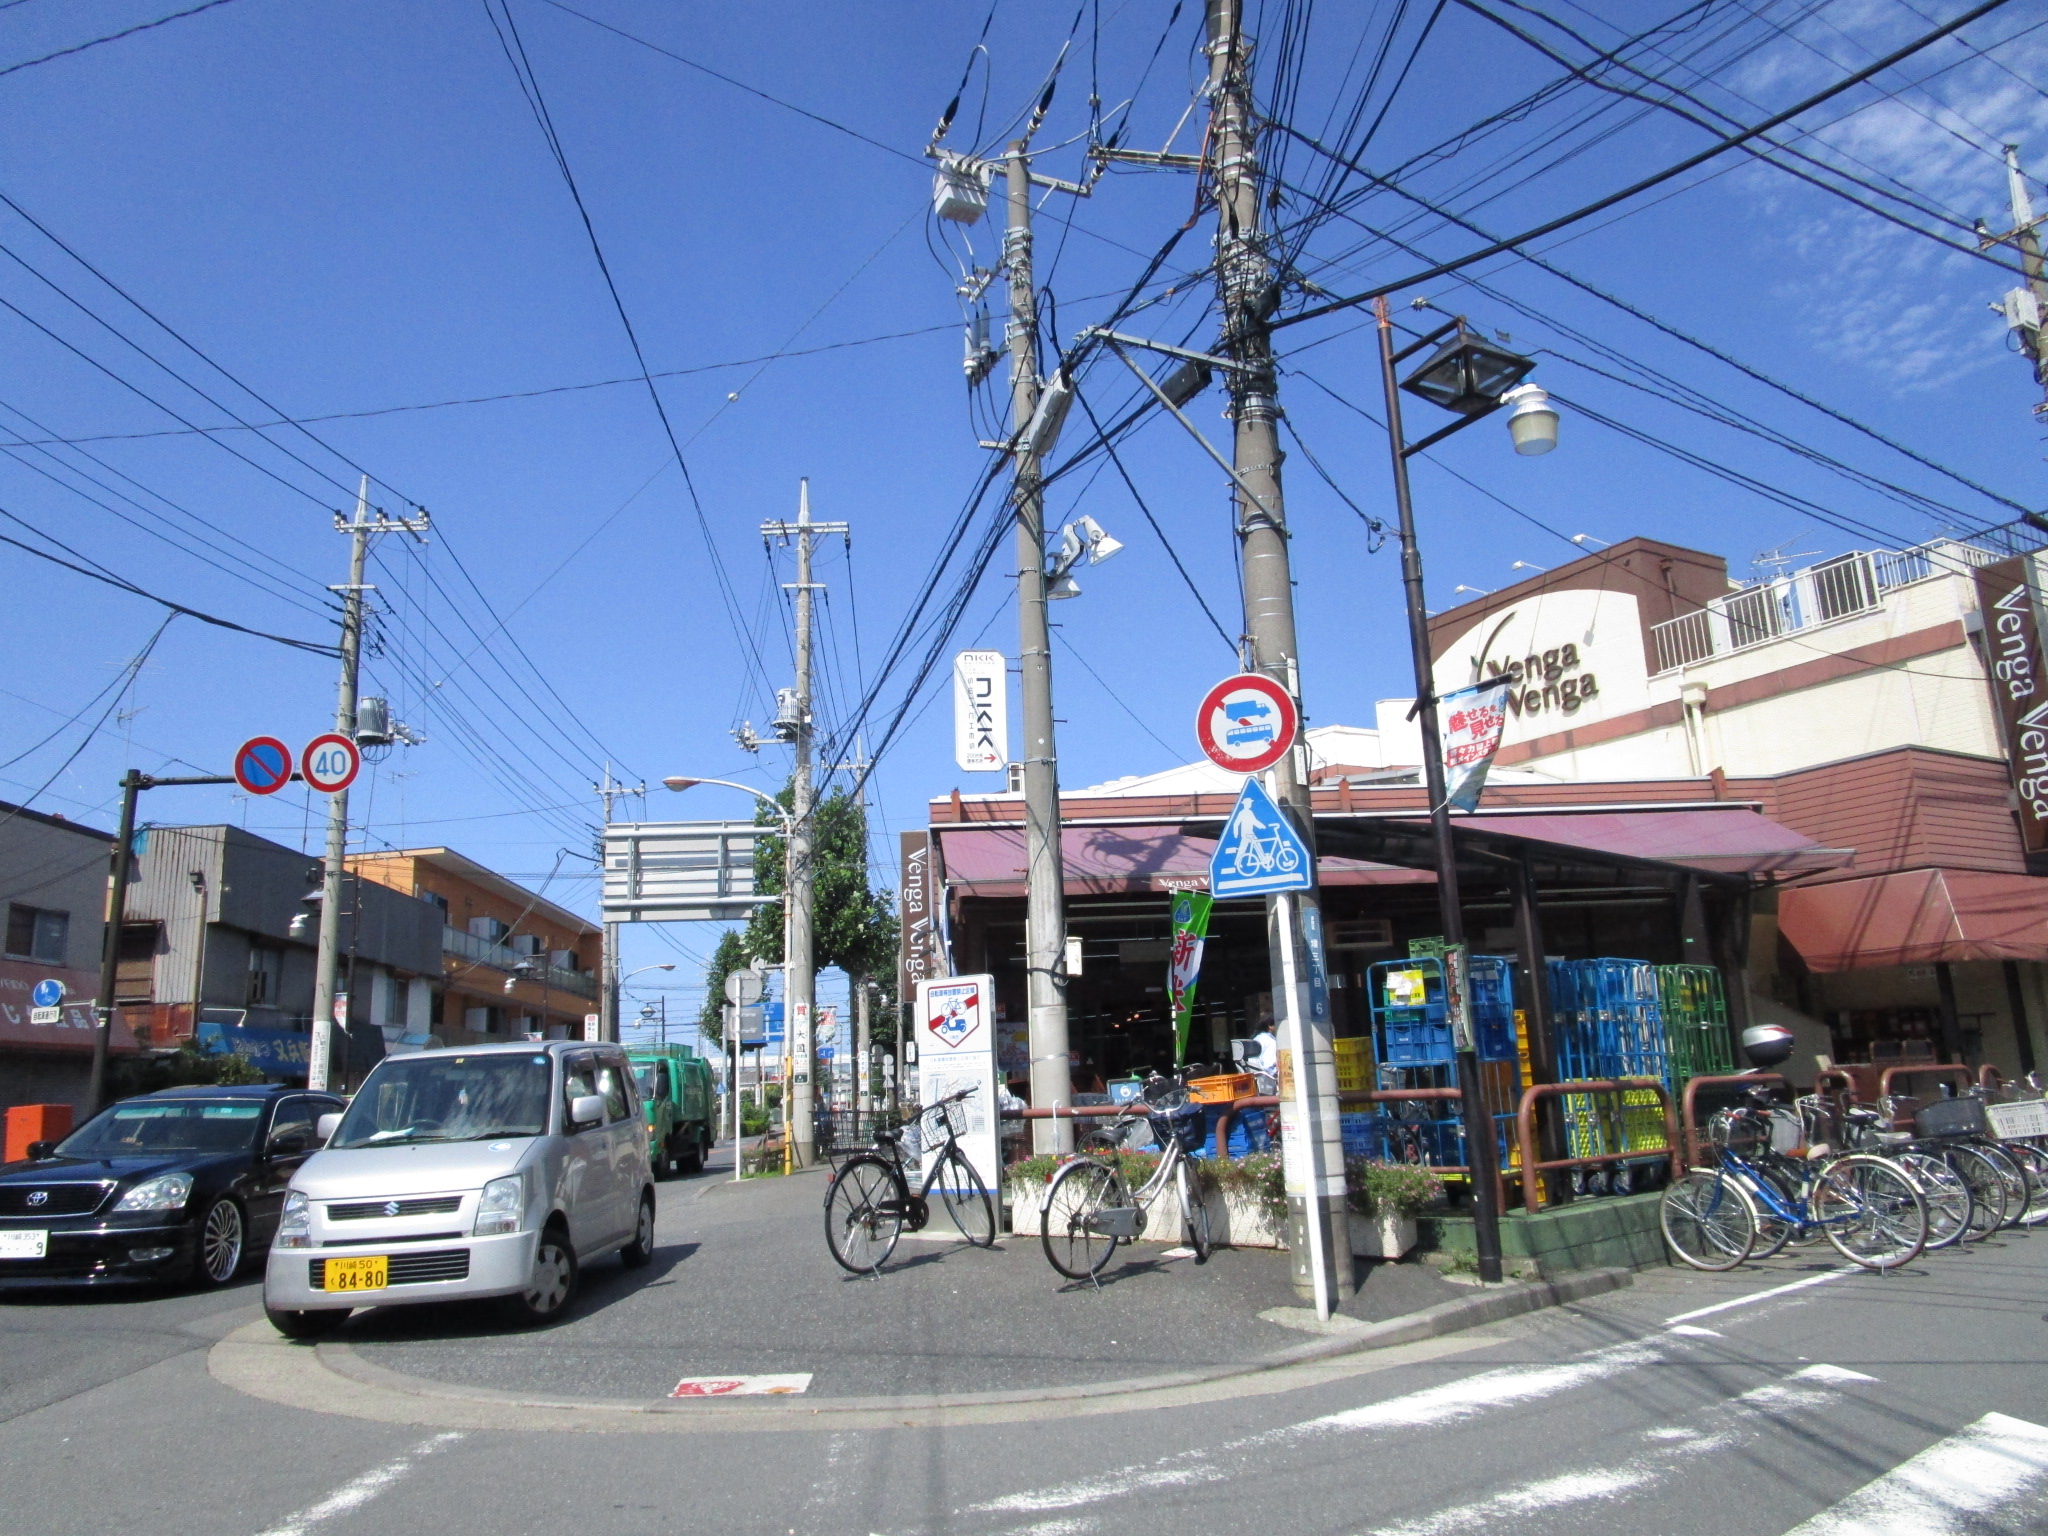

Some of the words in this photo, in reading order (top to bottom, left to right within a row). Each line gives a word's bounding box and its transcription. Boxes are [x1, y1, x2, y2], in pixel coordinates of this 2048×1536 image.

[1486, 642, 1581, 682] Venga
[1508, 673, 1600, 717] Venga
[1993, 583, 2035, 701] Venga
[2016, 700, 2048, 822] Venga
[976, 677, 993, 748] NKK
[315, 751, 346, 776] 40
[904, 846, 927, 914] Venga
[1158, 878, 1199, 888] Venga
[1316, 1002, 1323, 1015] 6
[36, 1241, 44, 1255] 9
[338, 1270, 384, 1289] 84-80
